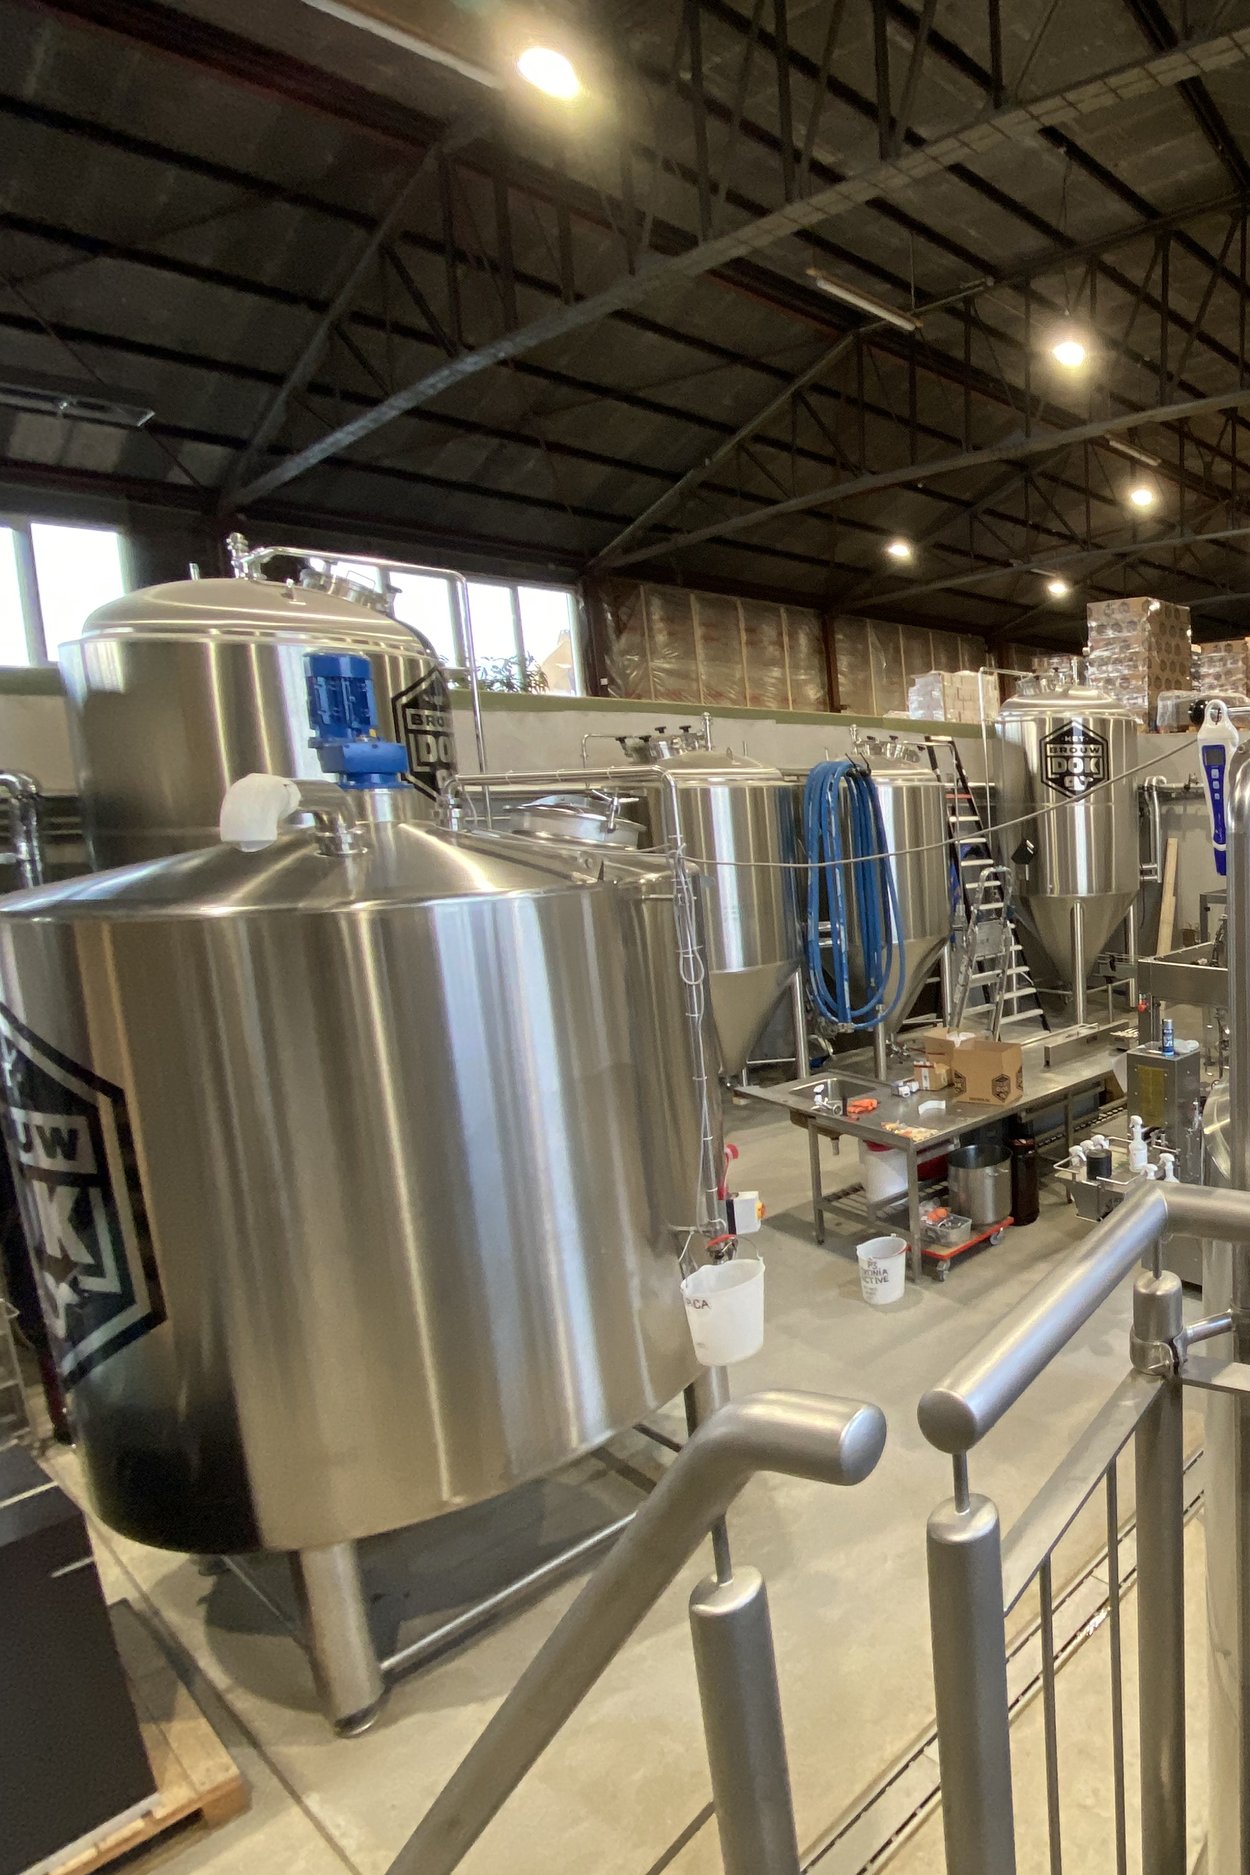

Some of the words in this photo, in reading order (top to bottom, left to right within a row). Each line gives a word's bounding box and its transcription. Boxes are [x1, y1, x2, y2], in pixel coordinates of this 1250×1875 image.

[411, 713, 451, 727] BRO
[417, 734, 454, 763] DO
[1049, 746, 1100, 754] BROUW
[1052, 757, 1100, 773] DOK
